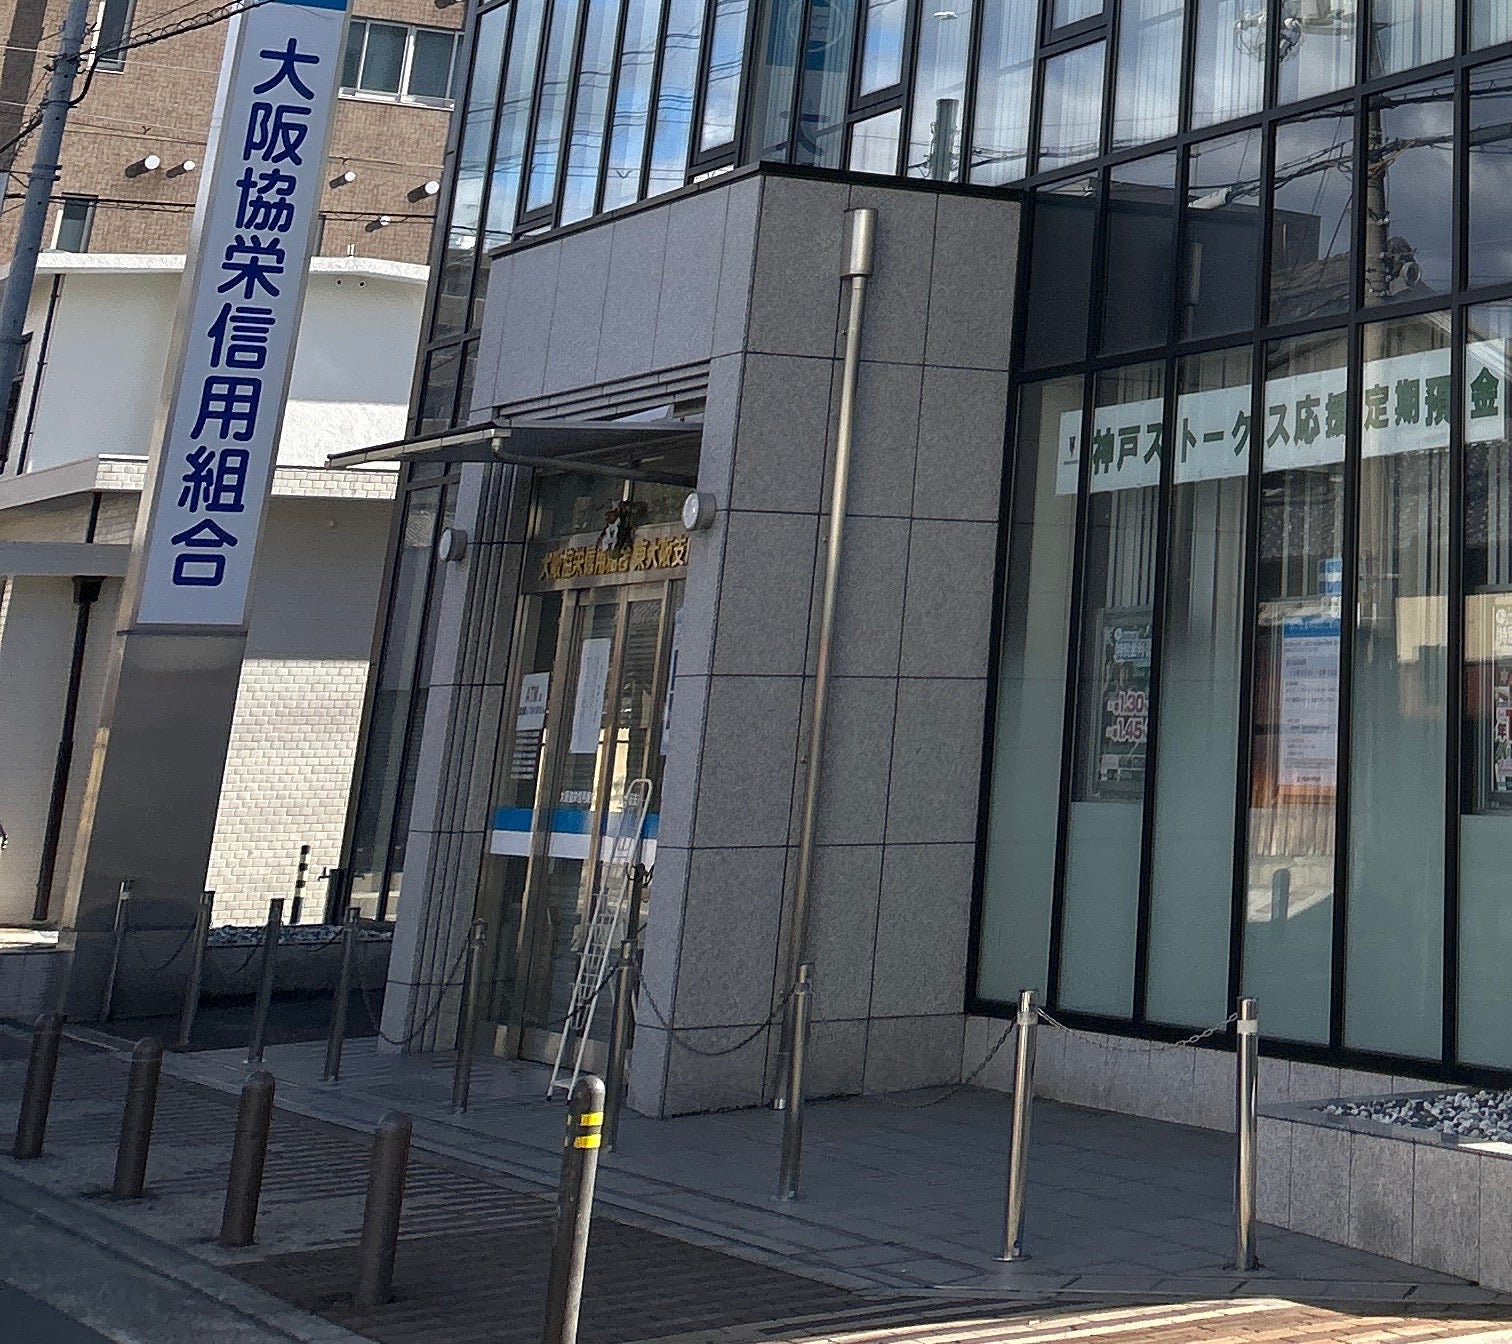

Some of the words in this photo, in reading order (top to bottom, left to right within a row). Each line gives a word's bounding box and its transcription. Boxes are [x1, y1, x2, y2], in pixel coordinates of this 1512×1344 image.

[171, 37, 320, 588] 大阪協栄信用組合
